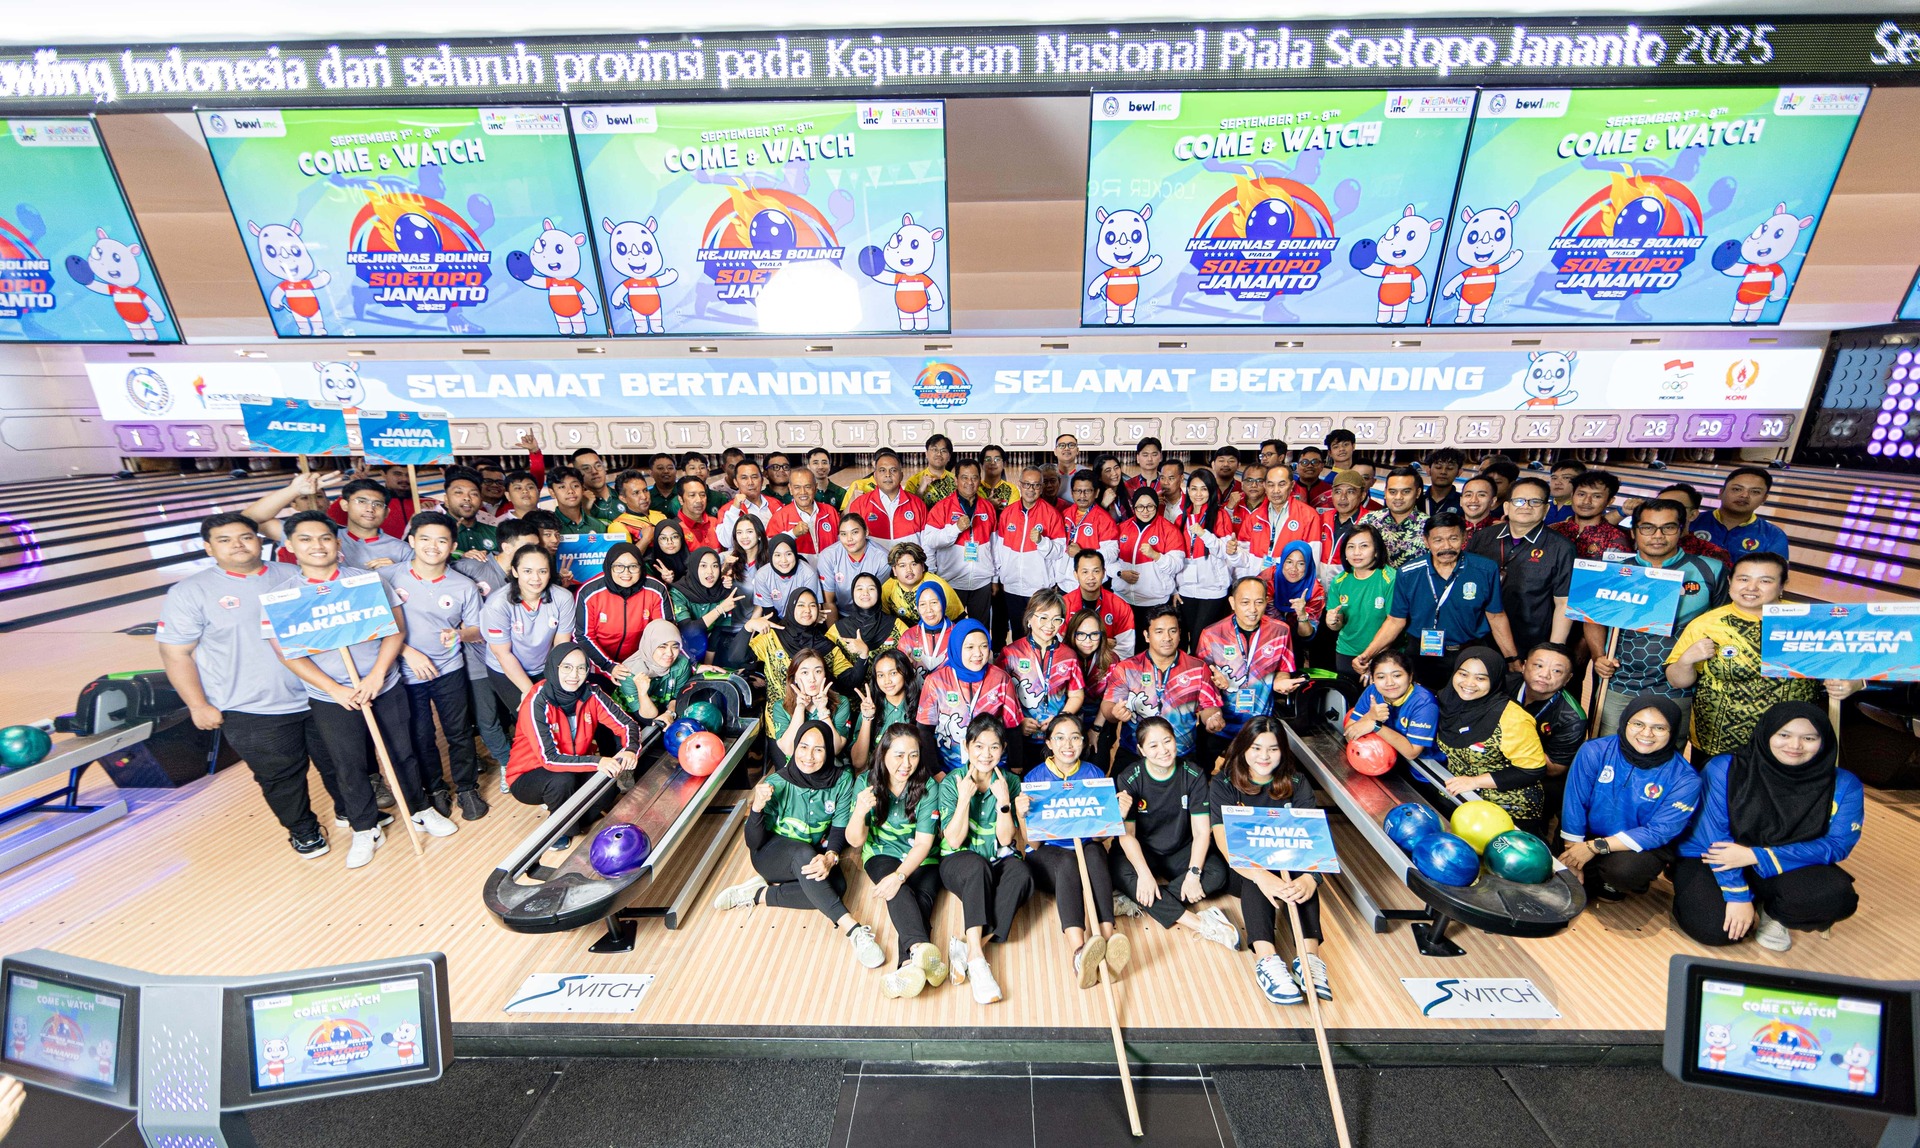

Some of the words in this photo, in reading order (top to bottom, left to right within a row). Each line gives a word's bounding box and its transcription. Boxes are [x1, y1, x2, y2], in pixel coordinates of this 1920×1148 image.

[0, 48, 117, 103] owling
[119, 45, 308, 94] Indonesia
[316, 44, 393, 90] dari
[402, 42, 543, 87] seluruh
[554, 39, 703, 93] provinsi
[716, 37, 812, 89] pada
[826, 35, 1021, 86] Kejuaraan
[1034, 30, 1207, 76] Nasional
[1218, 26, 1313, 69] Piala
[1324, 26, 1499, 78] Soetopo
[1504, 22, 1669, 68] Jananto
[1673, 24, 1778, 66] 2025
[1129, 101, 1172, 111] bowl.inc
[1391, 96, 1413, 109] play
[1515, 98, 1560, 109] bowl.inc
[1782, 93, 1805, 106] play
[606, 114, 649, 125] bowl.inc
[862, 107, 883, 119] play
[1606, 112, 1679, 128] SEPTEMBER
[1219, 115, 1293, 130] SEPTEMBER
[331, 132, 398, 146] SEPTEMBER
[701, 127, 769, 143] SEPTEMBER
[1173, 131, 1257, 161] COME
[1261, 137, 1277, 154] &
[1281, 120, 1383, 152] WATCH
[1557, 128, 1642, 159] COME
[1643, 135, 1660, 152] &
[1666, 118, 1766, 150] WATCH
[298, 148, 373, 176] COME
[378, 153, 392, 170] &
[393, 138, 486, 168] WATCH
[664, 142, 740, 172] COME
[746, 149, 760, 165] &
[762, 132, 855, 164] WATCH
[1187, 239, 1276, 250] KEJURNAS
[1278, 239, 1339, 250] BOLING
[1551, 238, 1642, 249] KEJURNAS
[1643, 237, 1705, 248] BOLING
[348, 253, 430, 264] KEJURNAS
[434, 252, 490, 263] BOLING
[698, 249, 782, 261] KEJURNAS
[786, 248, 843, 260] BOLING
[1200, 259, 1321, 273] SOETOPO
[1559, 258, 1685, 272] SOETOPO
[369, 272, 482, 286] SOETOPO
[715, 269, 779, 284] SOET
[1199, 274, 1319, 290] JANANTO
[1556, 273, 1679, 288] JANANTO
[0, 294, 53, 307] ANTO
[374, 287, 486, 301] JANANTO
[1238, 291, 1270, 299] 2025
[1594, 290, 1627, 298] 2025
[406, 373, 606, 398] SELAMAT
[618, 371, 892, 397] BERTANDING
[994, 368, 1197, 393] SELAMAT
[1209, 367, 1486, 392] BERTANDING
[267, 421, 326, 433] ACEH
[379, 428, 434, 438] JAWA
[736, 427, 751, 442] 12
[790, 427, 805, 442] 13
[849, 426, 864, 441] 14
[901, 426, 917, 440] 15
[960, 425, 976, 440] 16
[1016, 425, 1030, 440] 17
[1074, 423, 1091, 438] 18
[1129, 424, 1144, 439] 19
[1185, 423, 1207, 438] 20
[1242, 423, 1259, 439] 21
[1300, 422, 1321, 438] 22
[1354, 422, 1375, 438] 23
[1413, 422, 1436, 438] 24
[1467, 421, 1490, 438] 25
[1527, 421, 1551, 437] 26
[1583, 421, 1607, 437] 27
[1644, 421, 1668, 437] 28
[1697, 420, 1722, 436] 29
[1759, 419, 1784, 437] 30
[131, 429, 143, 446] 1
[185, 430, 201, 446] 2
[237, 430, 250, 446] 3
[370, 438, 445, 448] TENGAH
[457, 429, 469, 443] 7
[569, 429, 581, 444] 9
[624, 428, 641, 443] 10
[679, 428, 691, 443] 11
[559, 551, 608, 560] KALIMAN
[1684, 583, 1699, 591] PBI
[1595, 588, 1649, 605] RIAU
[311, 600, 350, 618] DKI
[279, 605, 389, 638] JAKARTA
[1769, 630, 1913, 642] SUMATERA
[1781, 642, 1899, 653] SELATAN
[1042, 796, 1099, 808] JAWA
[1041, 806, 1106, 820] BARAT
[1245, 825, 1310, 838] JAWA
[1246, 837, 1314, 849] TIMUR
[503, 975, 645, 1011] SWITCH
[1423, 979, 1541, 1016] SWITCH
[37, 995, 59, 1006] COME
[66, 999, 95, 1011] WATCH
[293, 1004, 328, 1019] COME
[339, 994, 381, 1010] WATCH
[1742, 1001, 1779, 1014] COME
[1791, 1005, 1837, 1018] WATCH
[314, 1050, 369, 1065] JANANTO
